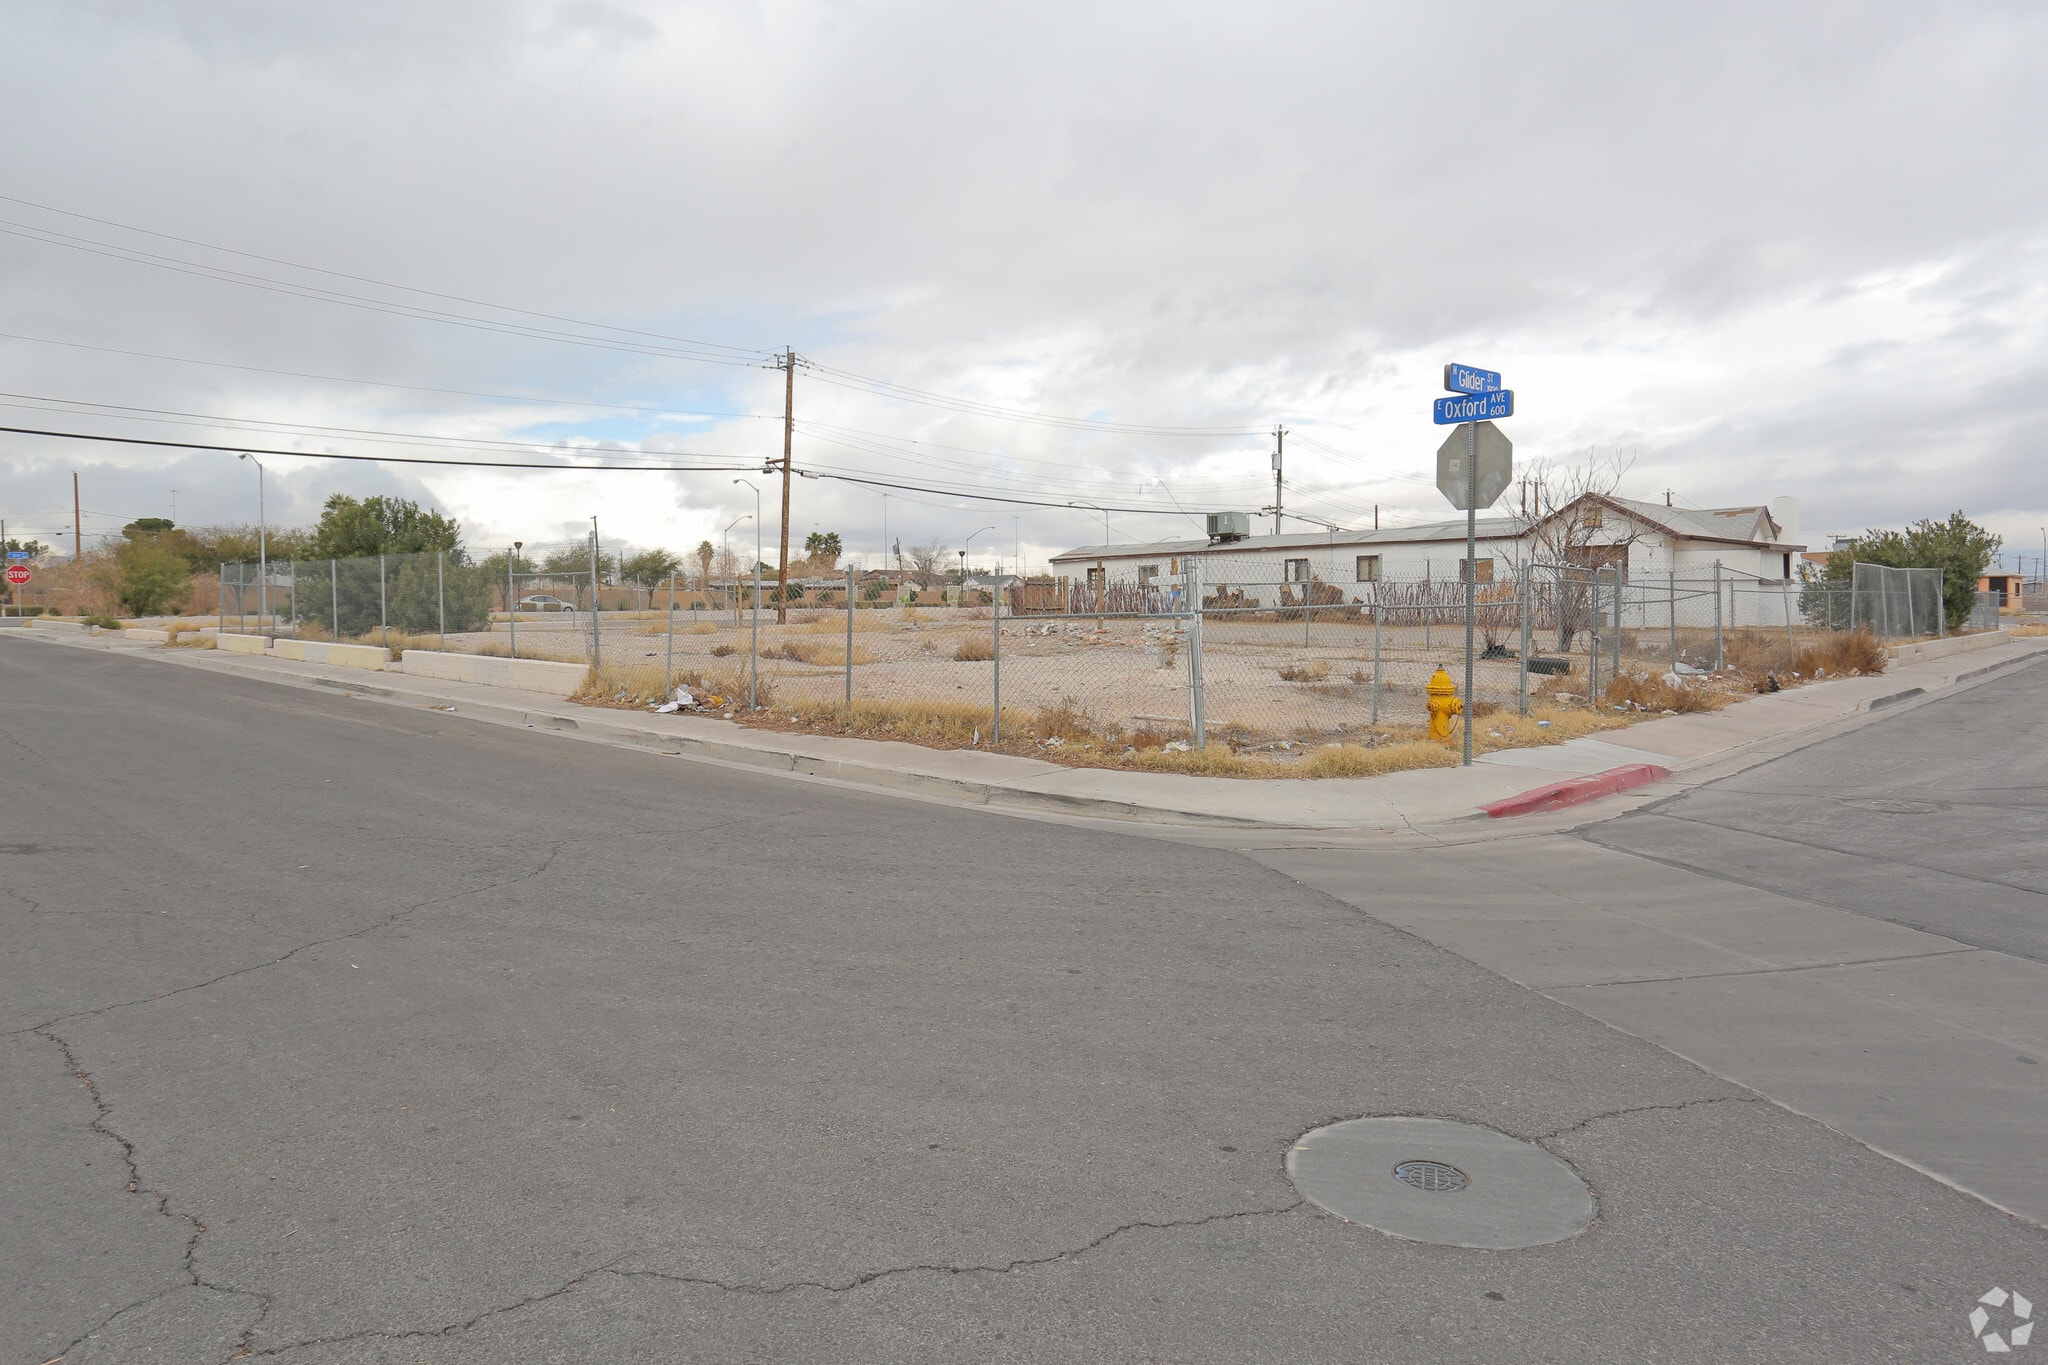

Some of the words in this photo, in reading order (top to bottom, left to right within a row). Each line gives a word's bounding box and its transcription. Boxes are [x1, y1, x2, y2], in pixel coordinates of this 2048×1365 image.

[1452, 365, 1458, 376] N
[1458, 369, 1485, 391] Glider
[1487, 373, 1494, 383] ST
[1437, 400, 1442, 410] E
[1445, 397, 1487, 419] Oxford
[1490, 392, 1506, 403] AVE
[1490, 405, 1506, 416] 600
